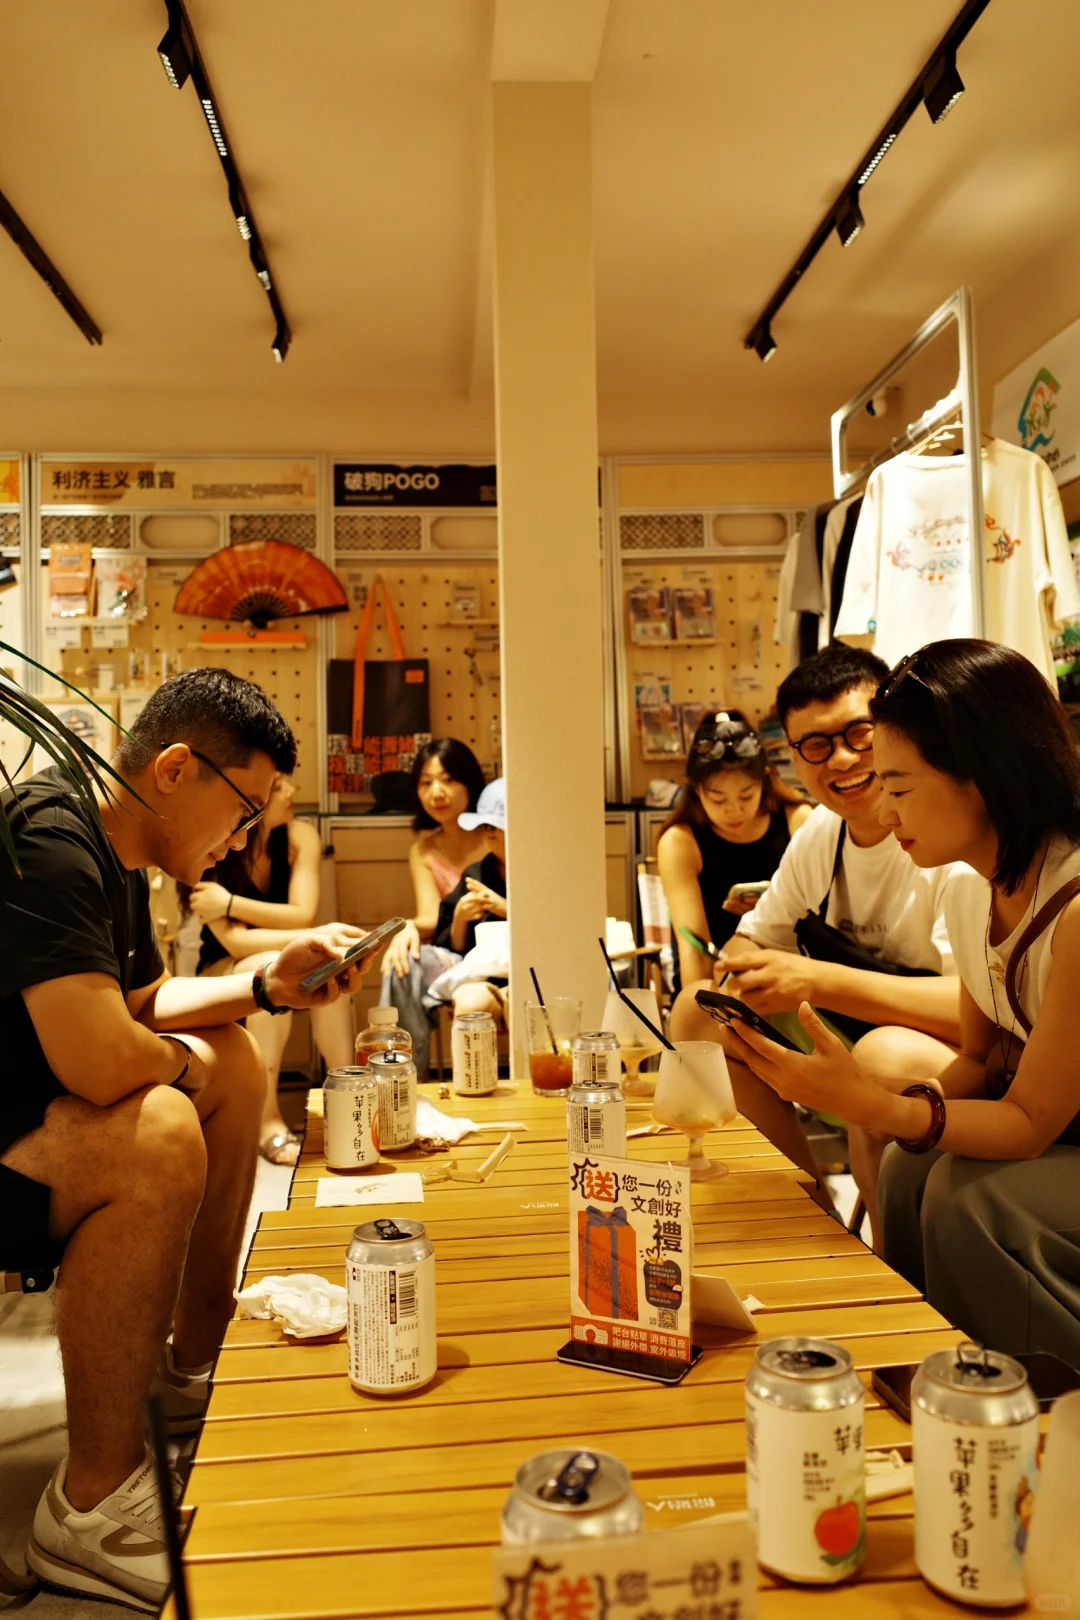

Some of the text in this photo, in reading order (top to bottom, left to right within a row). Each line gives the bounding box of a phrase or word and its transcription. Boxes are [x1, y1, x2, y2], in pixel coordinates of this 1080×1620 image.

[53, 470, 176, 489] 利济主义 雅言
[344, 472, 440, 491] 破狗POGO
[352, 1095, 366, 1161] 苹果多自在
[586, 1169, 672, 1203] 送 您一份
[631, 1195, 682, 1219] 文創好
[652, 1219, 683, 1253] 禮
[612, 1326, 648, 1342] 吧台點單
[650, 1333, 687, 1349] 消費落座
[612, 1337, 687, 1360] 謝絕外帶 室外吸煙
[950, 1436, 980, 1591] 苹果多自在
